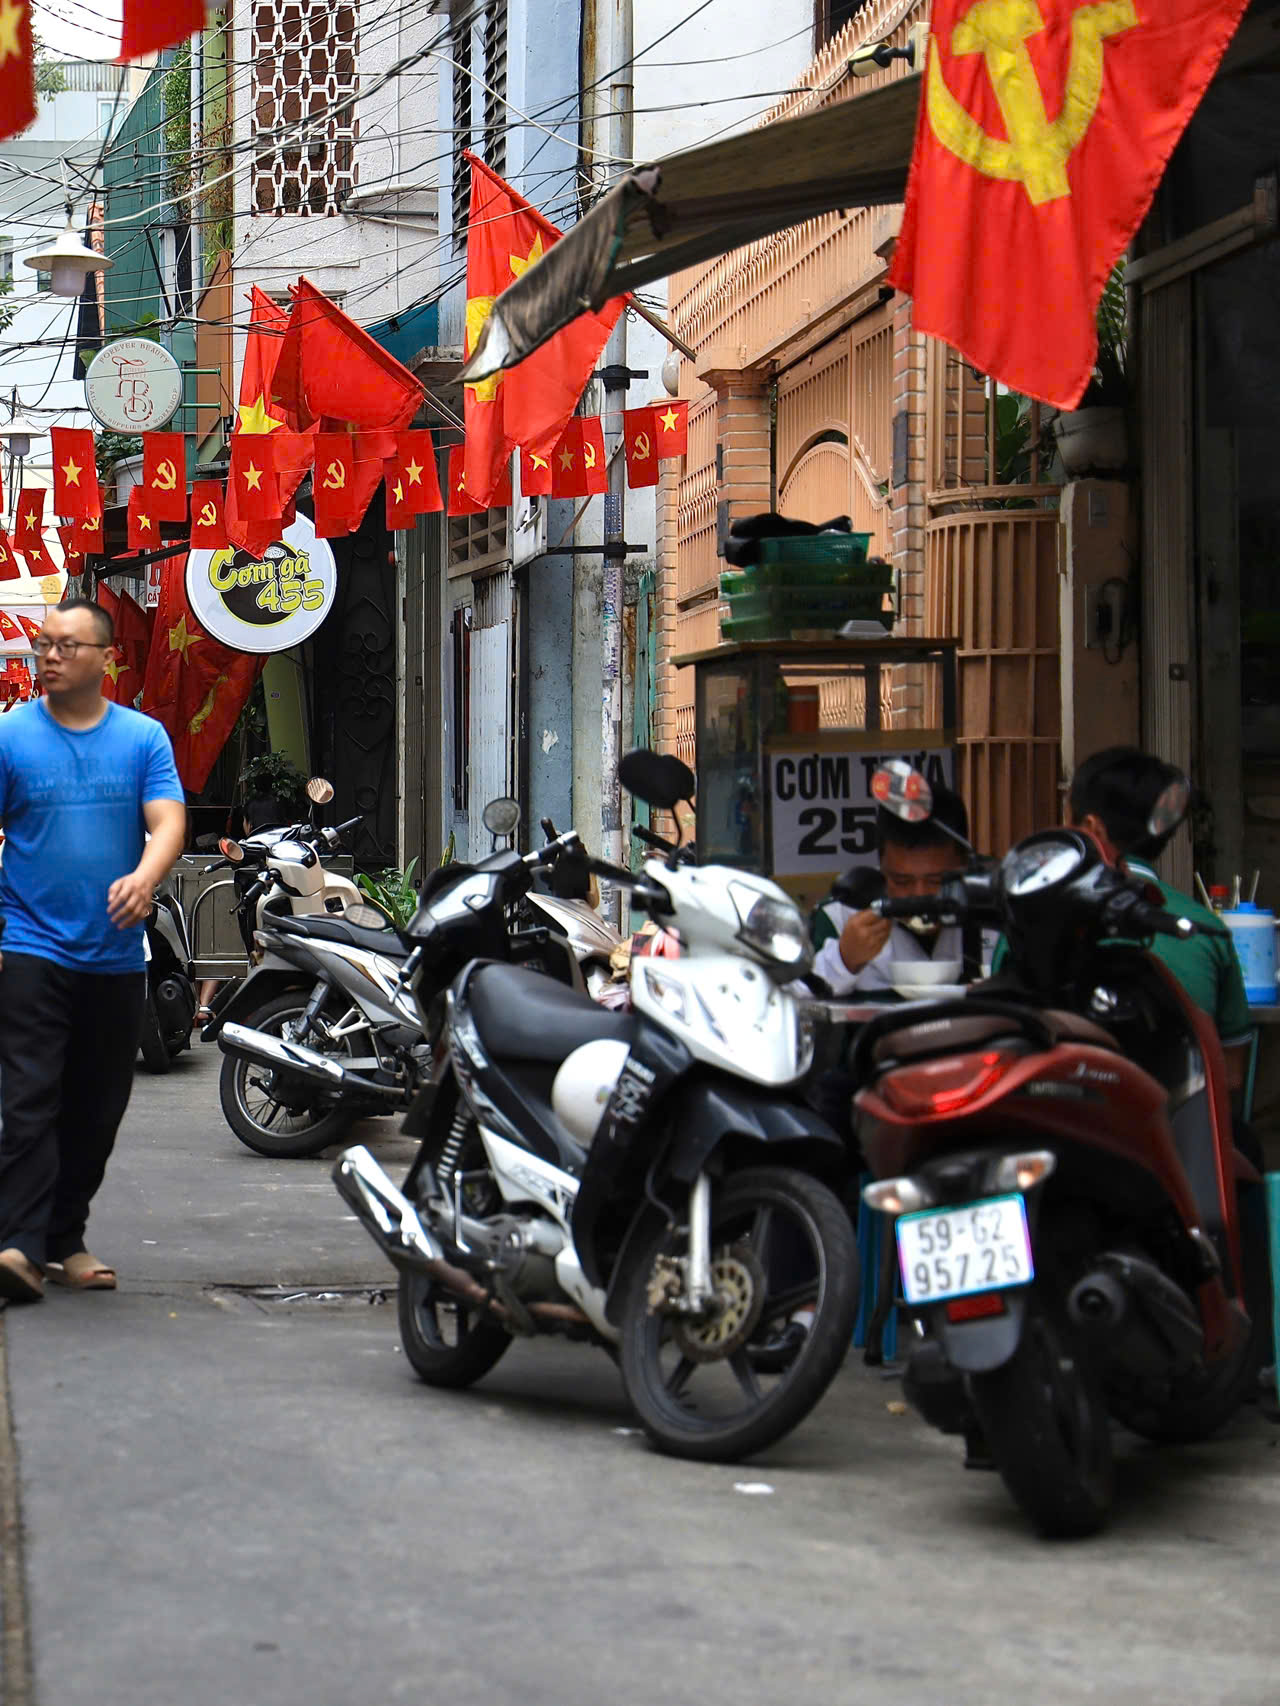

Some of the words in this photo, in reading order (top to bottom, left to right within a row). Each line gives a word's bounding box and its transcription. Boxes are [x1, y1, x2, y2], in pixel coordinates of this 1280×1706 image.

[99, 342, 136, 364] FOREVER
[140, 343, 170, 364] BEAUTY
[89, 384, 97, 403] NAIL
[208, 544, 275, 592] Cơm
[278, 548, 312, 583] gà
[256, 578, 325, 613] 455
[775, 754, 851, 801] CƠM
[913, 1244, 1022, 1296] 957.25
